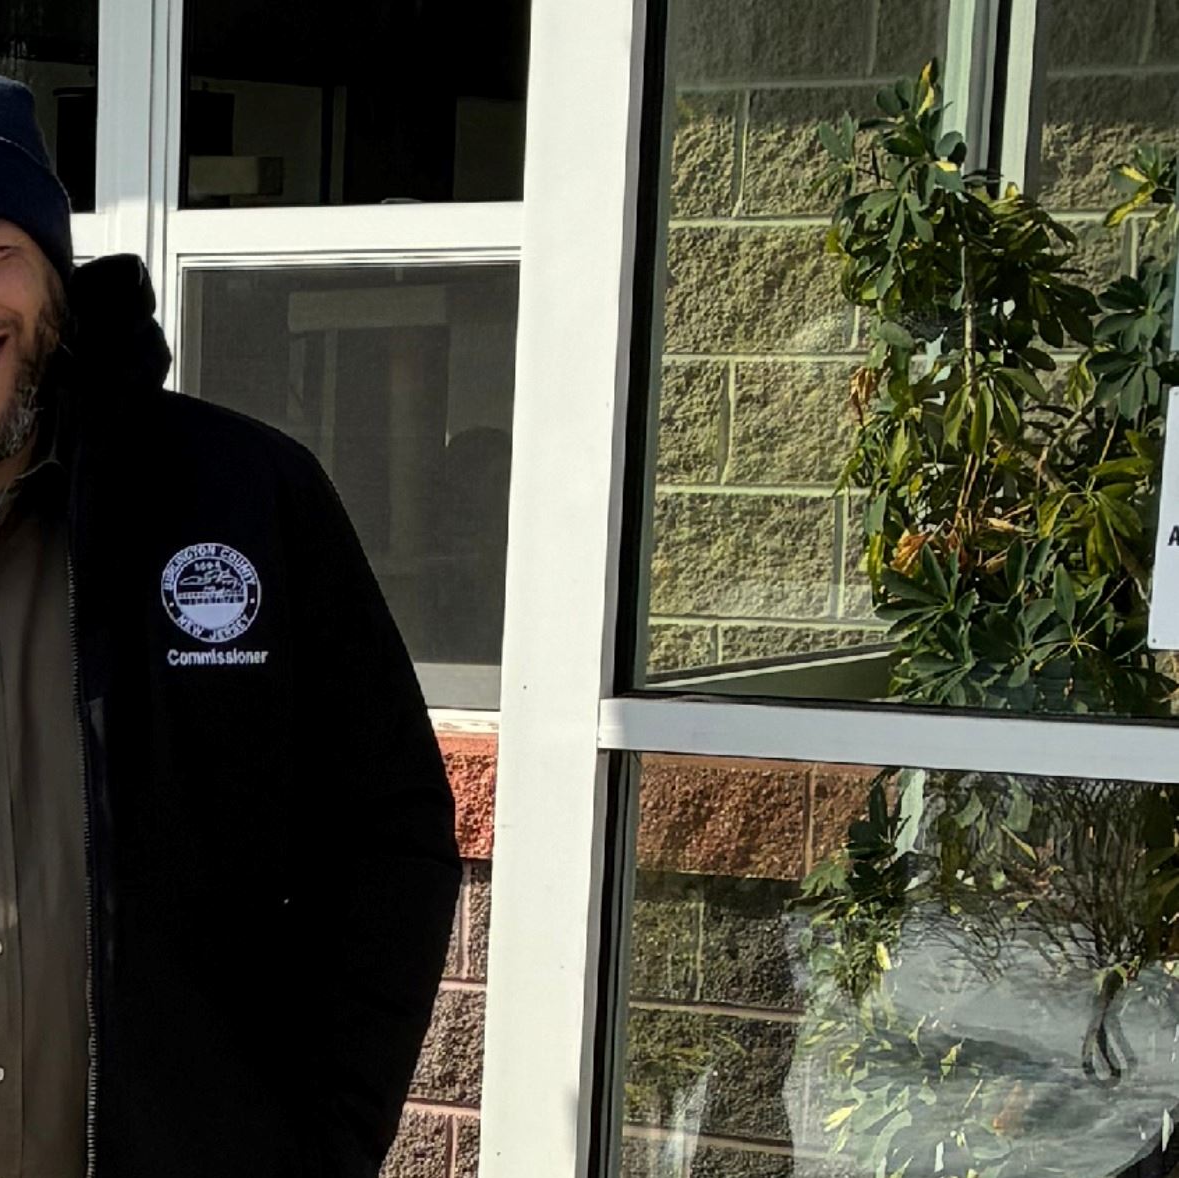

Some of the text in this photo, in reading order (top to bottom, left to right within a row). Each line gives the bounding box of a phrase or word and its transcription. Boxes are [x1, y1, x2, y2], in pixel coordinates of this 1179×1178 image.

[220, 549, 257, 585] COUNTY
[176, 613, 204, 639] NEW
[167, 648, 269, 666] Commissioner
